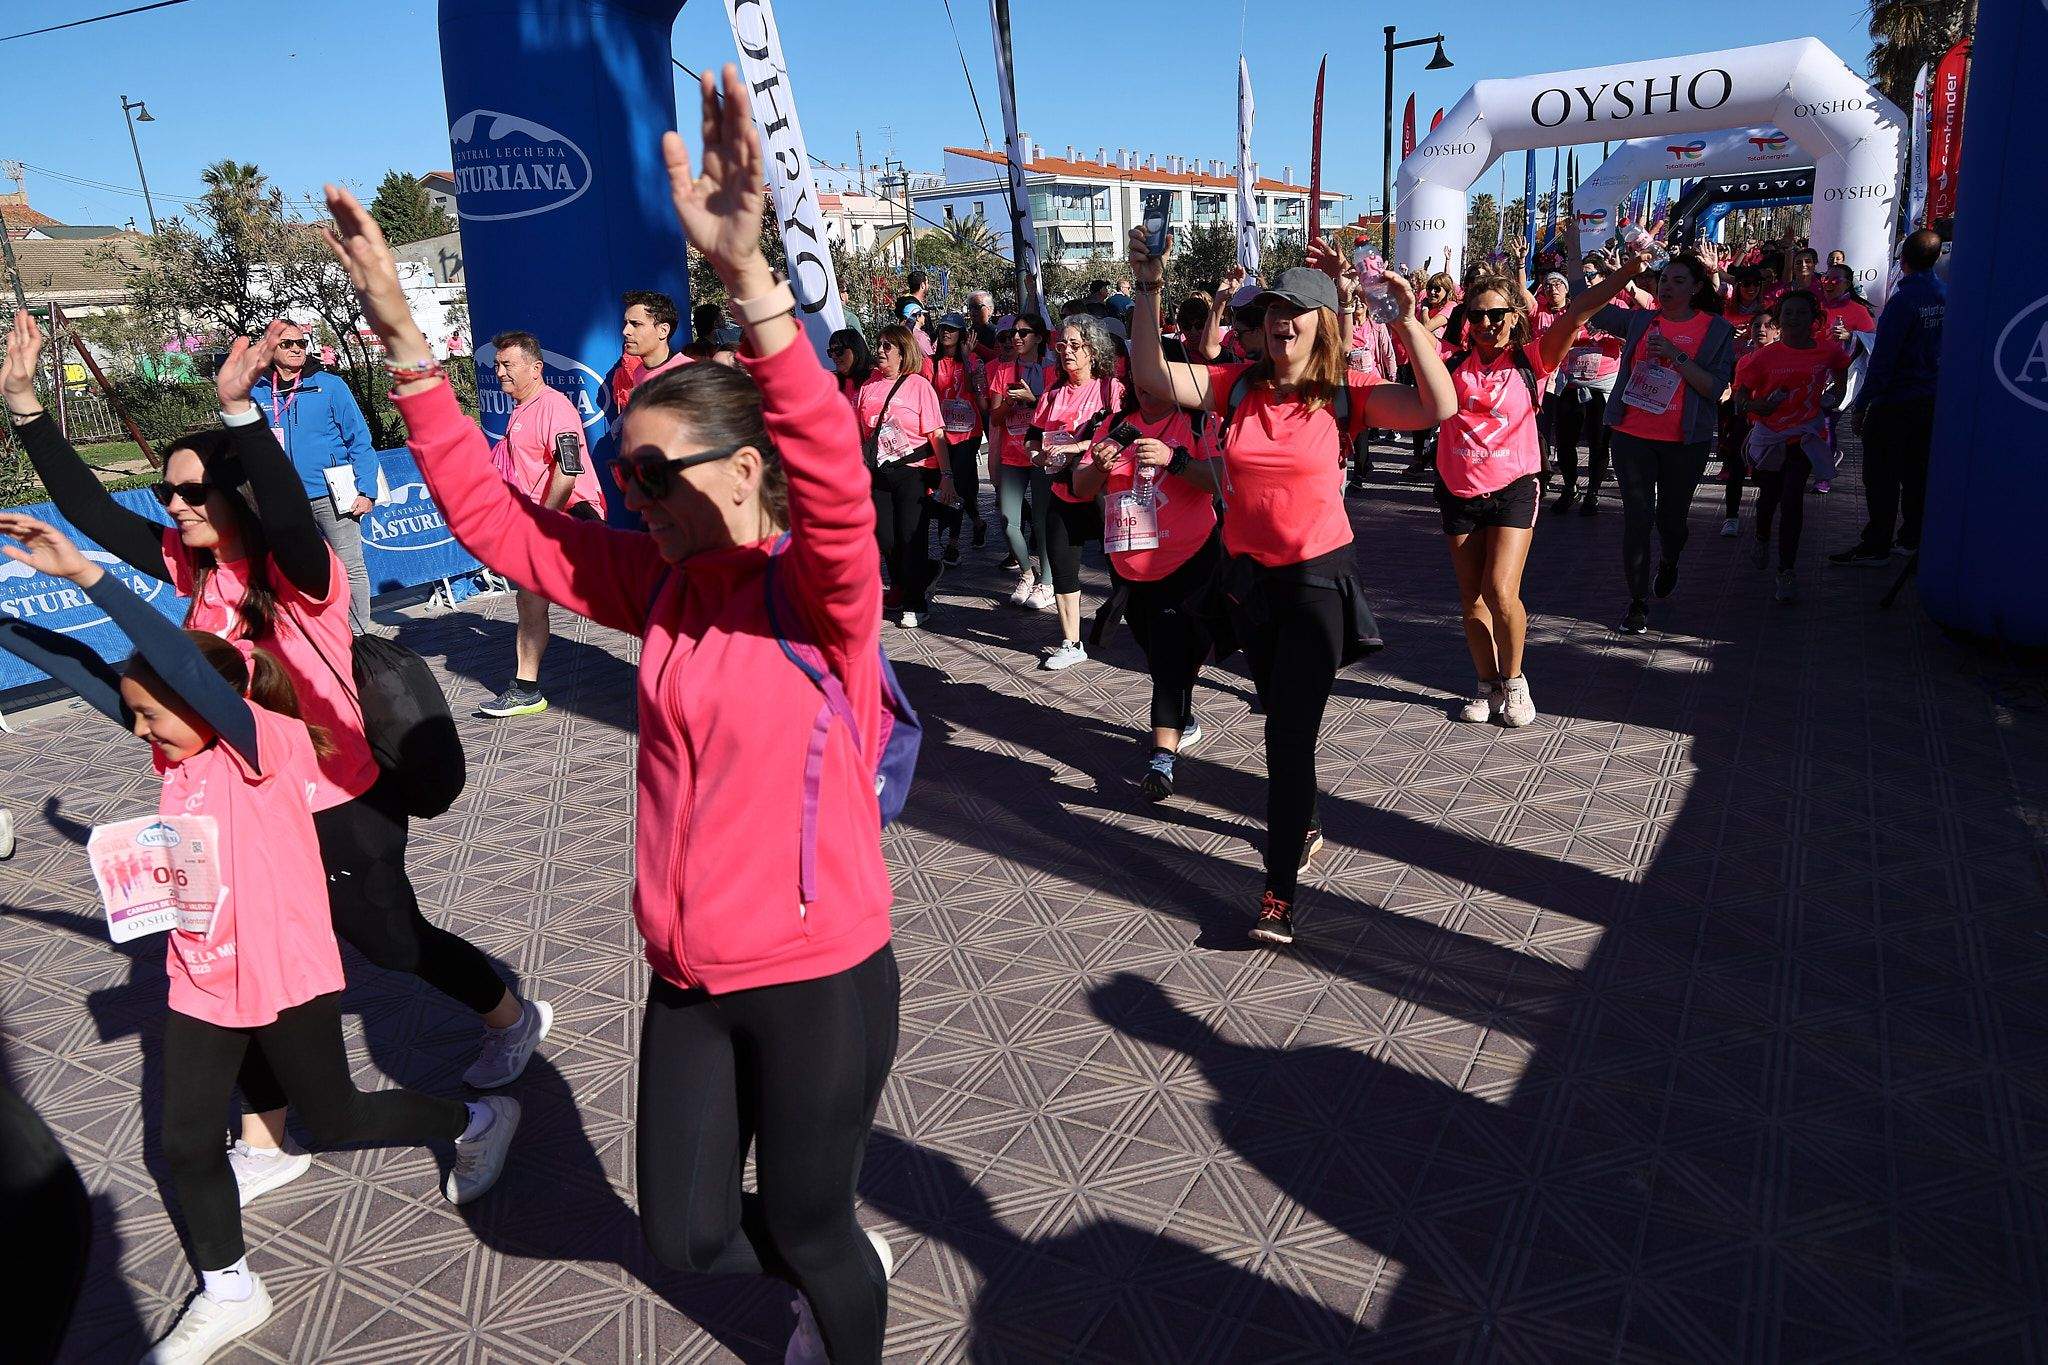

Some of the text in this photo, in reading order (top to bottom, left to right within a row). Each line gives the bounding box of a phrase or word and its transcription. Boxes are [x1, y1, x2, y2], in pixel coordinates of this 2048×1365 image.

[1531, 68, 1733, 128] OYSHO
[1794, 98, 1862, 118] OYSHO
[497, 147, 565, 158] LECHERA
[1423, 142, 1476, 158] OYSHO
[1748, 152, 1789, 162] TotalEnergies
[1665, 161, 1706, 170] TotalEnergies
[456, 164, 576, 195] STURIANA
[1721, 178, 1806, 193] VOLVO
[1824, 183, 1887, 202] OYSHO
[1398, 218, 1446, 233] OYSHO
[1641, 383, 1659, 394] 016
[384, 504, 424, 518] CENTRAL
[1116, 516, 1137, 528] 016
